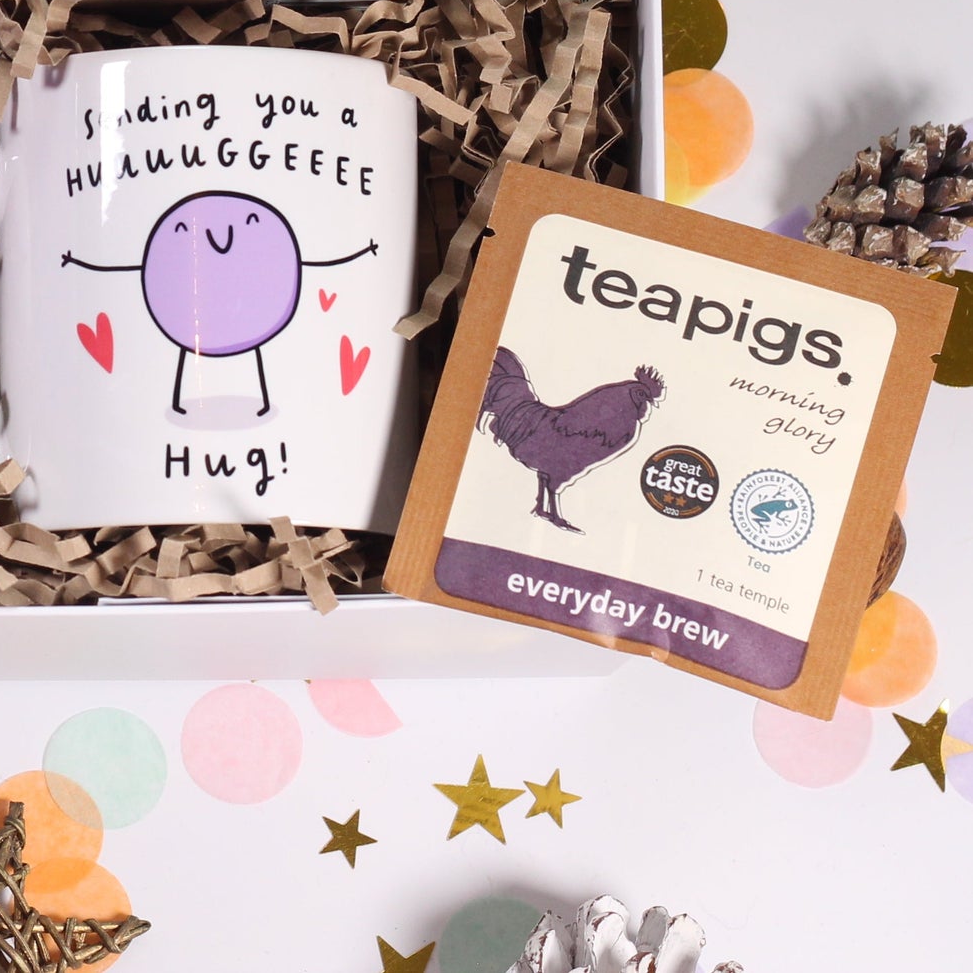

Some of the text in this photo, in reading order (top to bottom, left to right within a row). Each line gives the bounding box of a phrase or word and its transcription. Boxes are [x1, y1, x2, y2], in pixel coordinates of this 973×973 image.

[84, 91, 358, 140] Snding you a
[729, 377, 845, 425] morning
[763, 417, 836, 455] glory
[165, 442, 288, 497] Hug!
[645, 465, 714, 502] taste
[664, 458, 703, 477] great
[737, 475, 809, 525] RAINFOREST ALLIANCE
[736, 511, 759, 542] PEOPLE
[769, 530, 801, 547] NATURE
[747, 555, 771, 573] Tea
[507, 572, 729, 650] everyday brew
[697, 569, 790, 615] 1 tea temple
